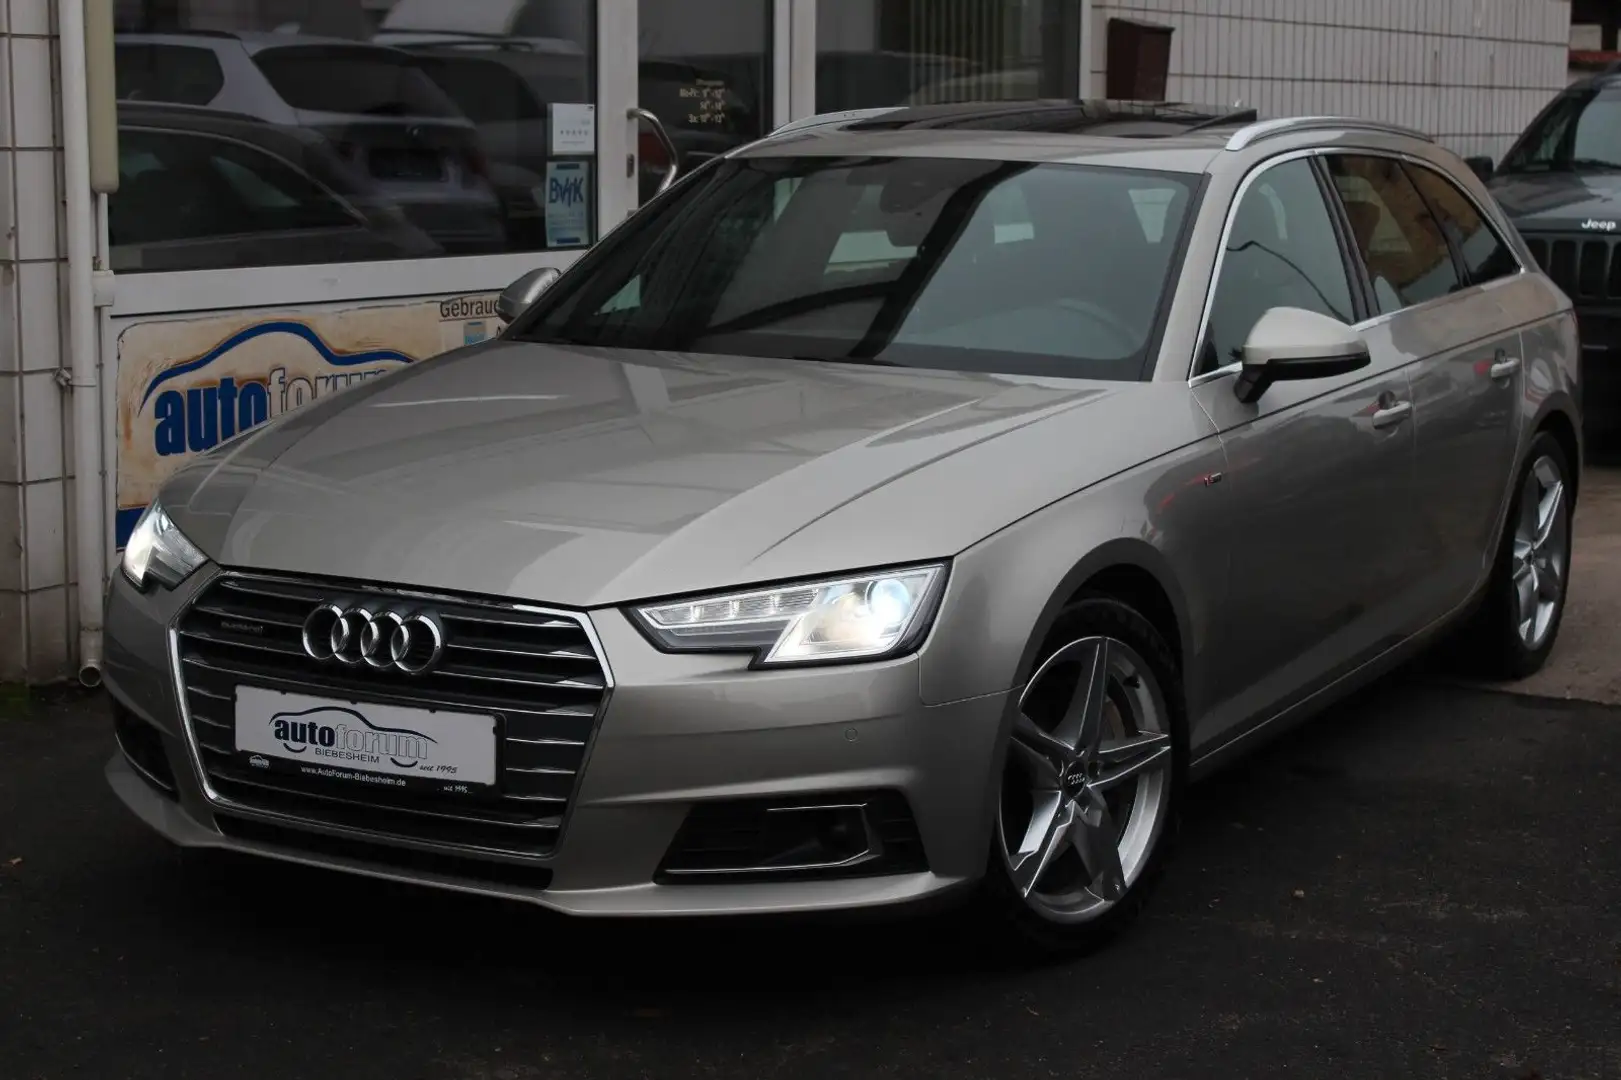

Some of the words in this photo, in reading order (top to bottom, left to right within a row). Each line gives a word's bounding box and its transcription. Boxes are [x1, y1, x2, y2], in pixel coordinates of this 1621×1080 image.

[1581, 217, 1617, 232] Jeep
[274, 719, 428, 760] autoforum
[314, 747, 380, 764] BIEBESHEIM
[436, 765, 459, 775] 1995
